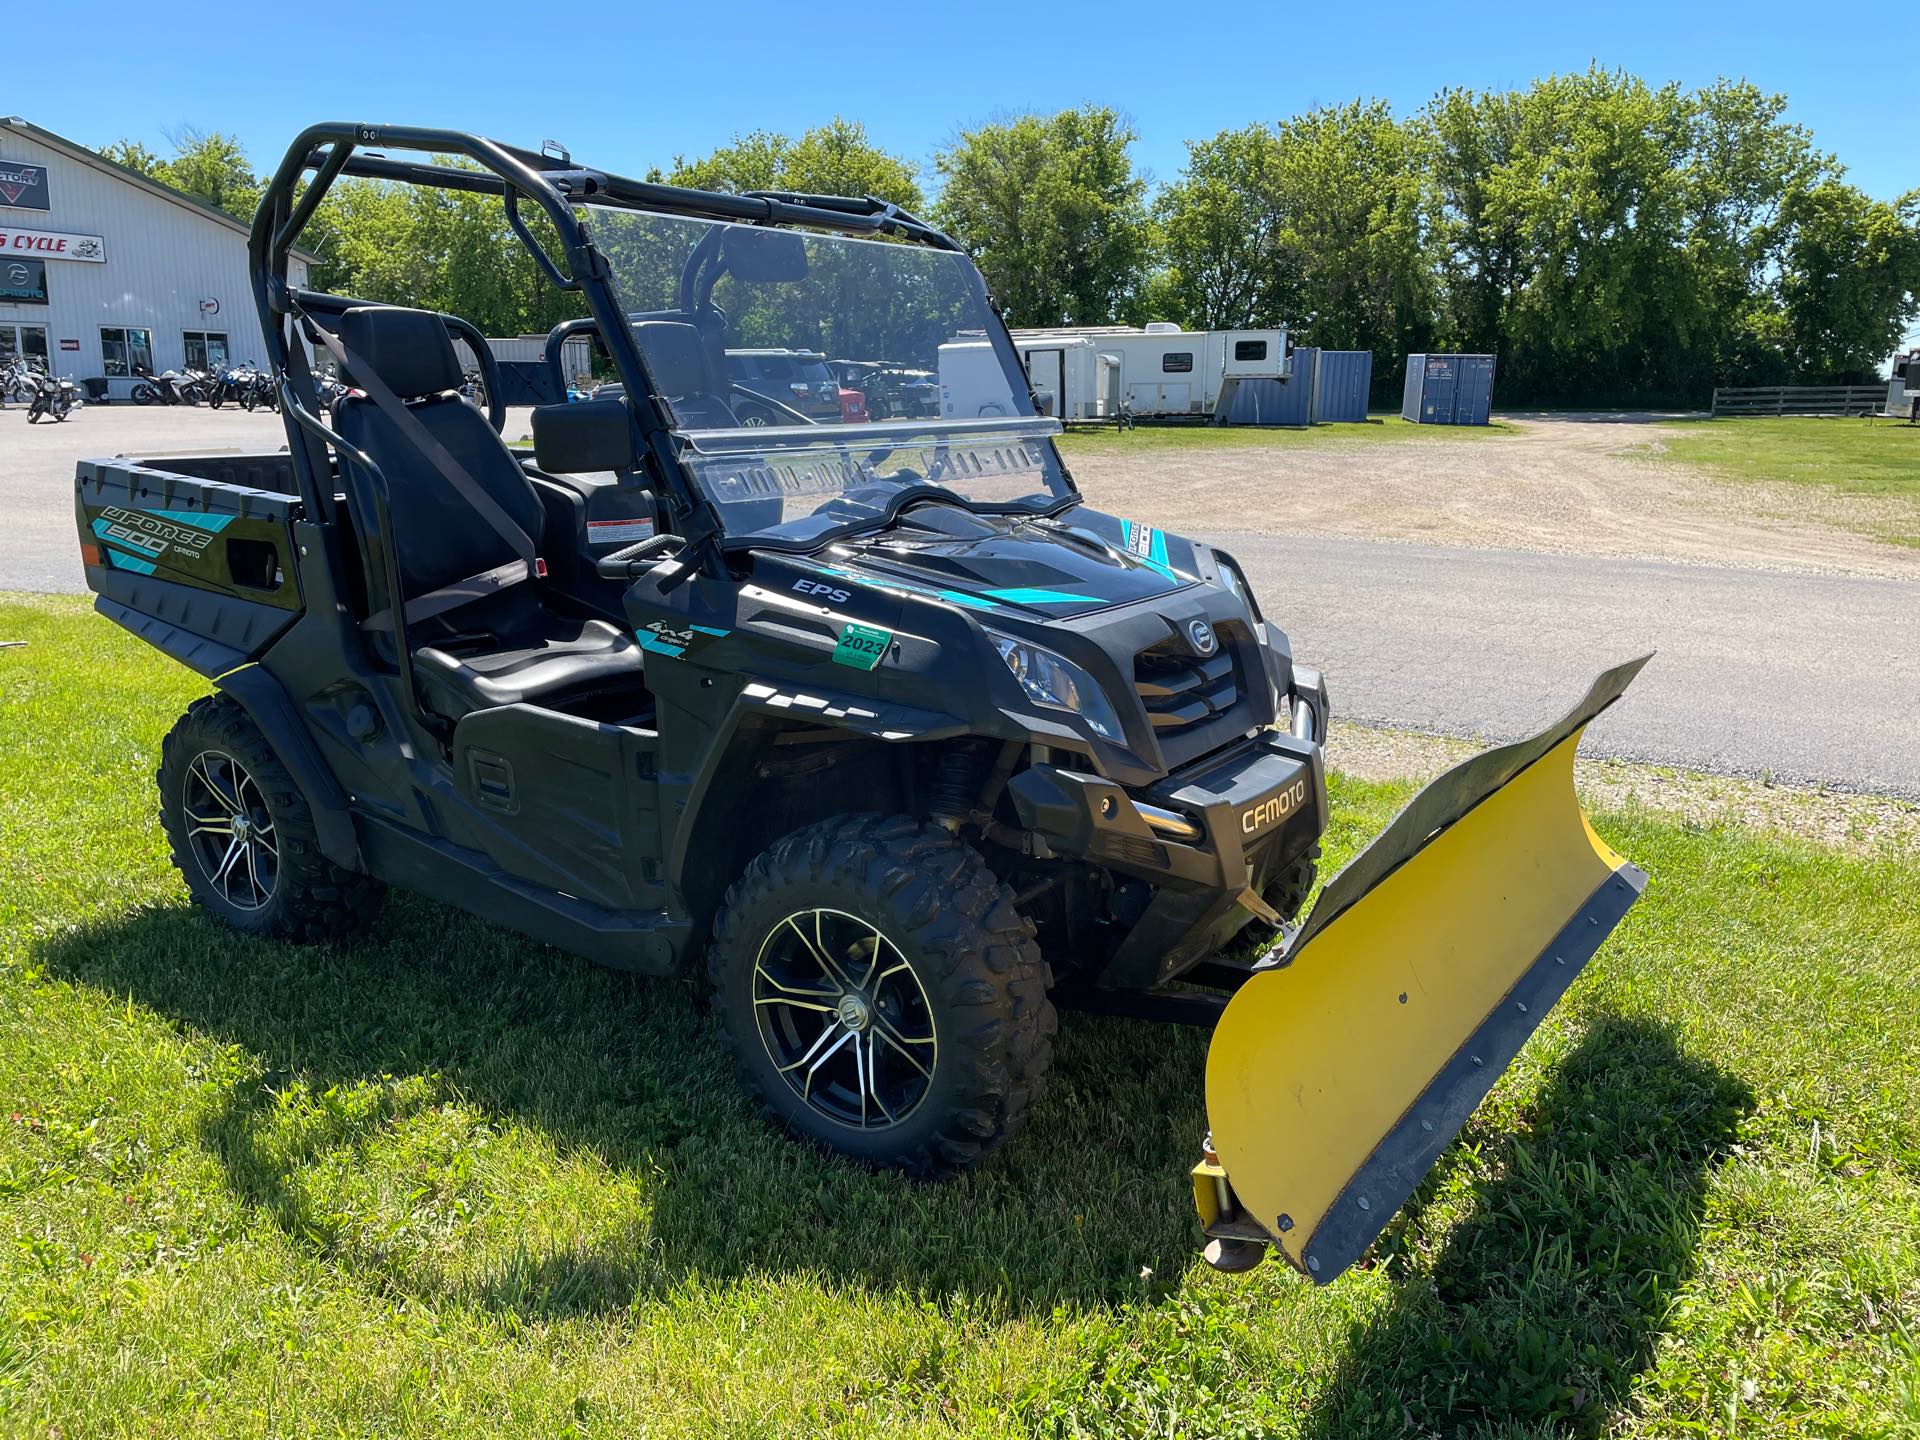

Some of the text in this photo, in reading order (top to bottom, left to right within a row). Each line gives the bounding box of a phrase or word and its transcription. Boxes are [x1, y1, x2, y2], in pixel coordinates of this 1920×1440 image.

[13, 235, 67, 252] CYCLE
[101, 506, 213, 549] UFORCE
[106, 525, 169, 552] 800
[174, 546, 199, 559] CFMOTO
[791, 579, 851, 603] EPS
[841, 635, 883, 655] 2023
[1242, 779, 1304, 833] CFMOTO
